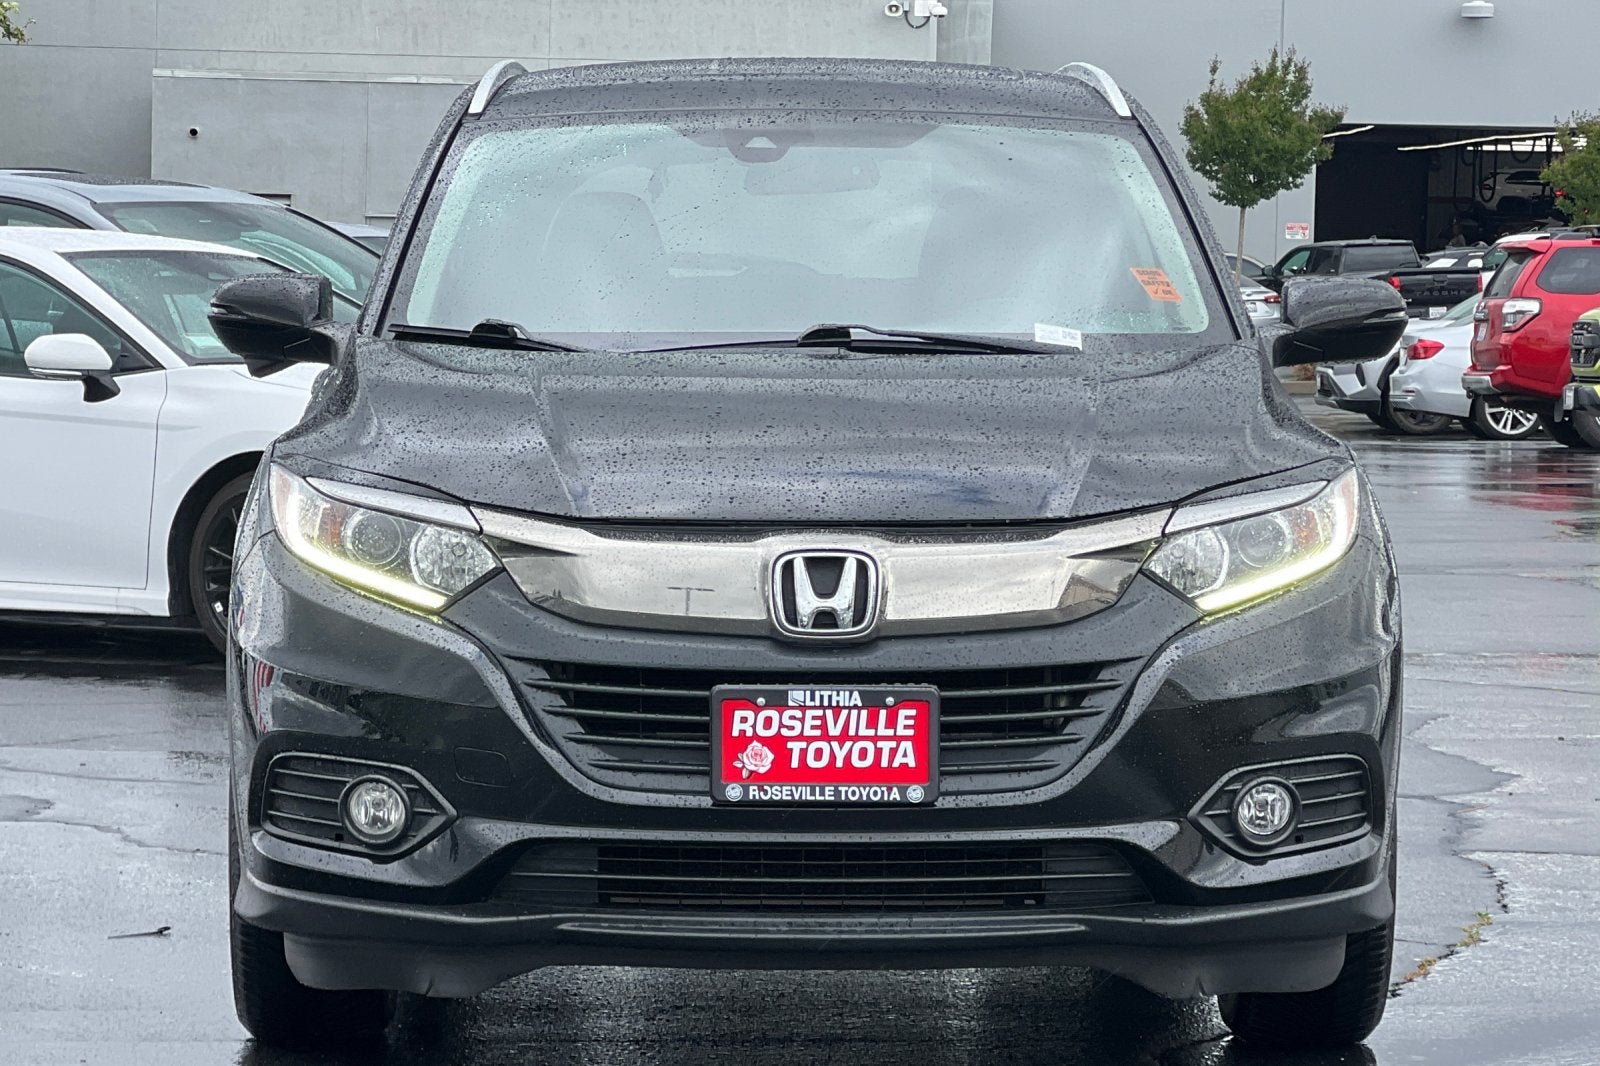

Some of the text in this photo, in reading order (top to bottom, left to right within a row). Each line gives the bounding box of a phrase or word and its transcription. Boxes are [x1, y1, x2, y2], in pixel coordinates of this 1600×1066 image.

[805, 690, 862, 706] LITHIA
[731, 709, 917, 737] ROSEVILLE
[786, 741, 916, 768] TOYOTA
[749, 785, 900, 801] ROSEVILLE TOYOTA
